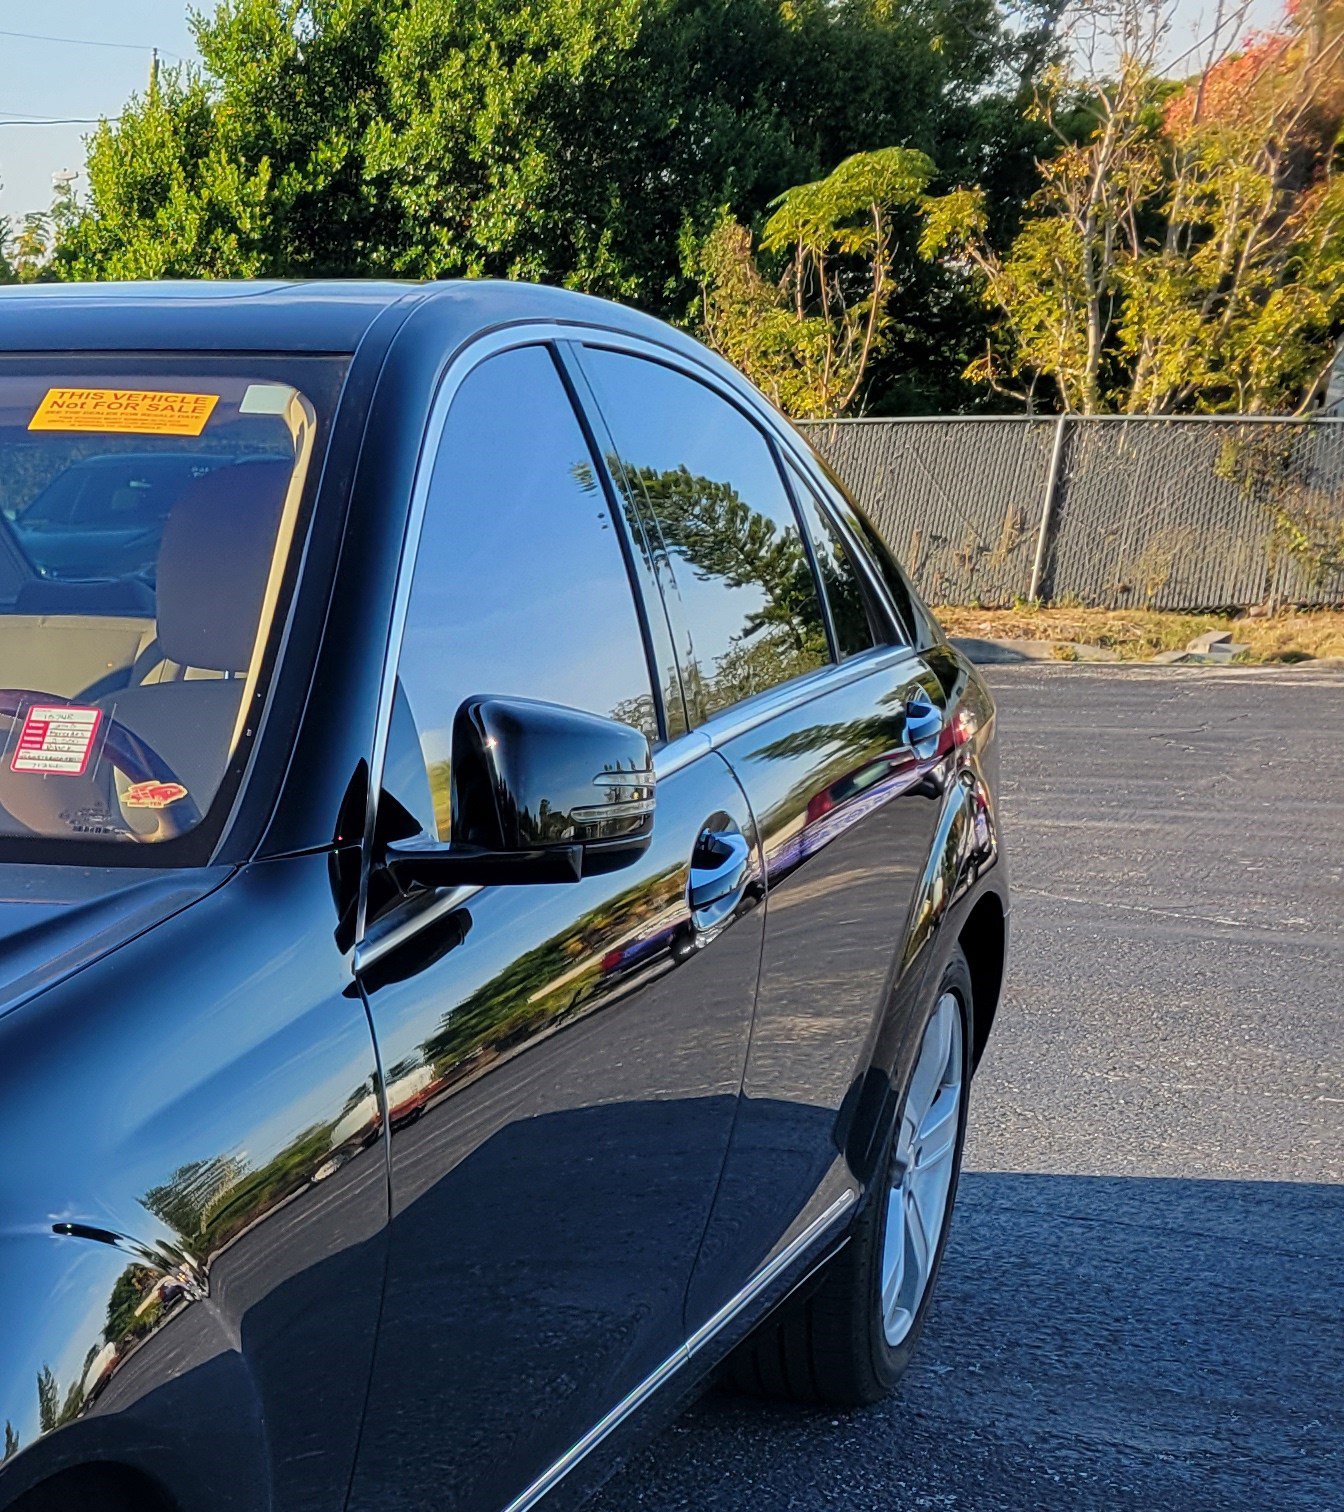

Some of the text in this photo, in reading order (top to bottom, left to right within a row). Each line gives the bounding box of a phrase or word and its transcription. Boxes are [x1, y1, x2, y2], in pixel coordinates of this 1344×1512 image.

[56, 391, 209, 405] THIS VEHICLE
[49, 400, 207, 414] Not FOR SALE
